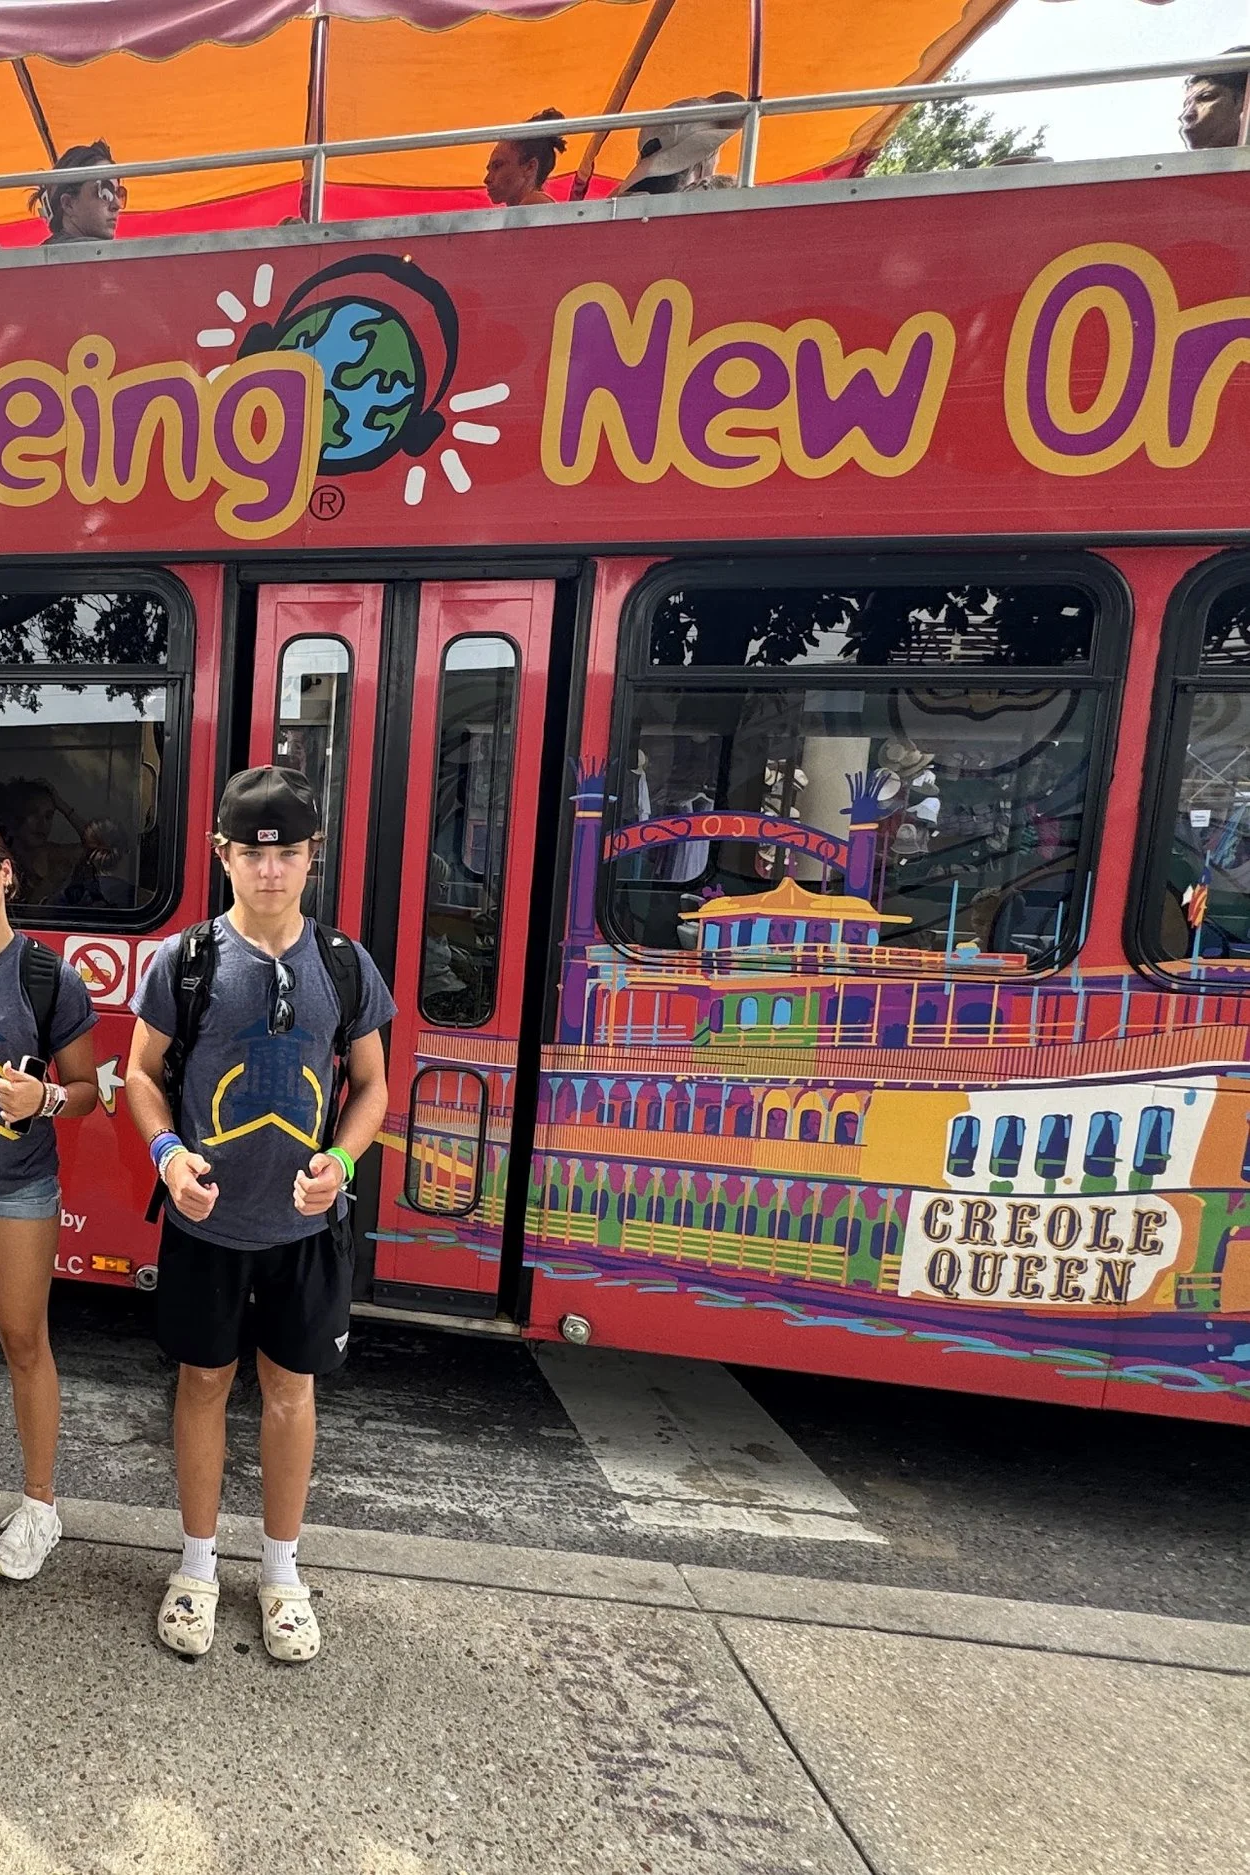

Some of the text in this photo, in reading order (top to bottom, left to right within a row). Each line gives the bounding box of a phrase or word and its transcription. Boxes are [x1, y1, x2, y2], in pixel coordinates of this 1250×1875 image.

[540, 279, 956, 488] New
[60, 1208, 87, 1233] by
[920, 1197, 1167, 1256] CREOLE
[925, 1249, 1137, 1305] QUEEN
